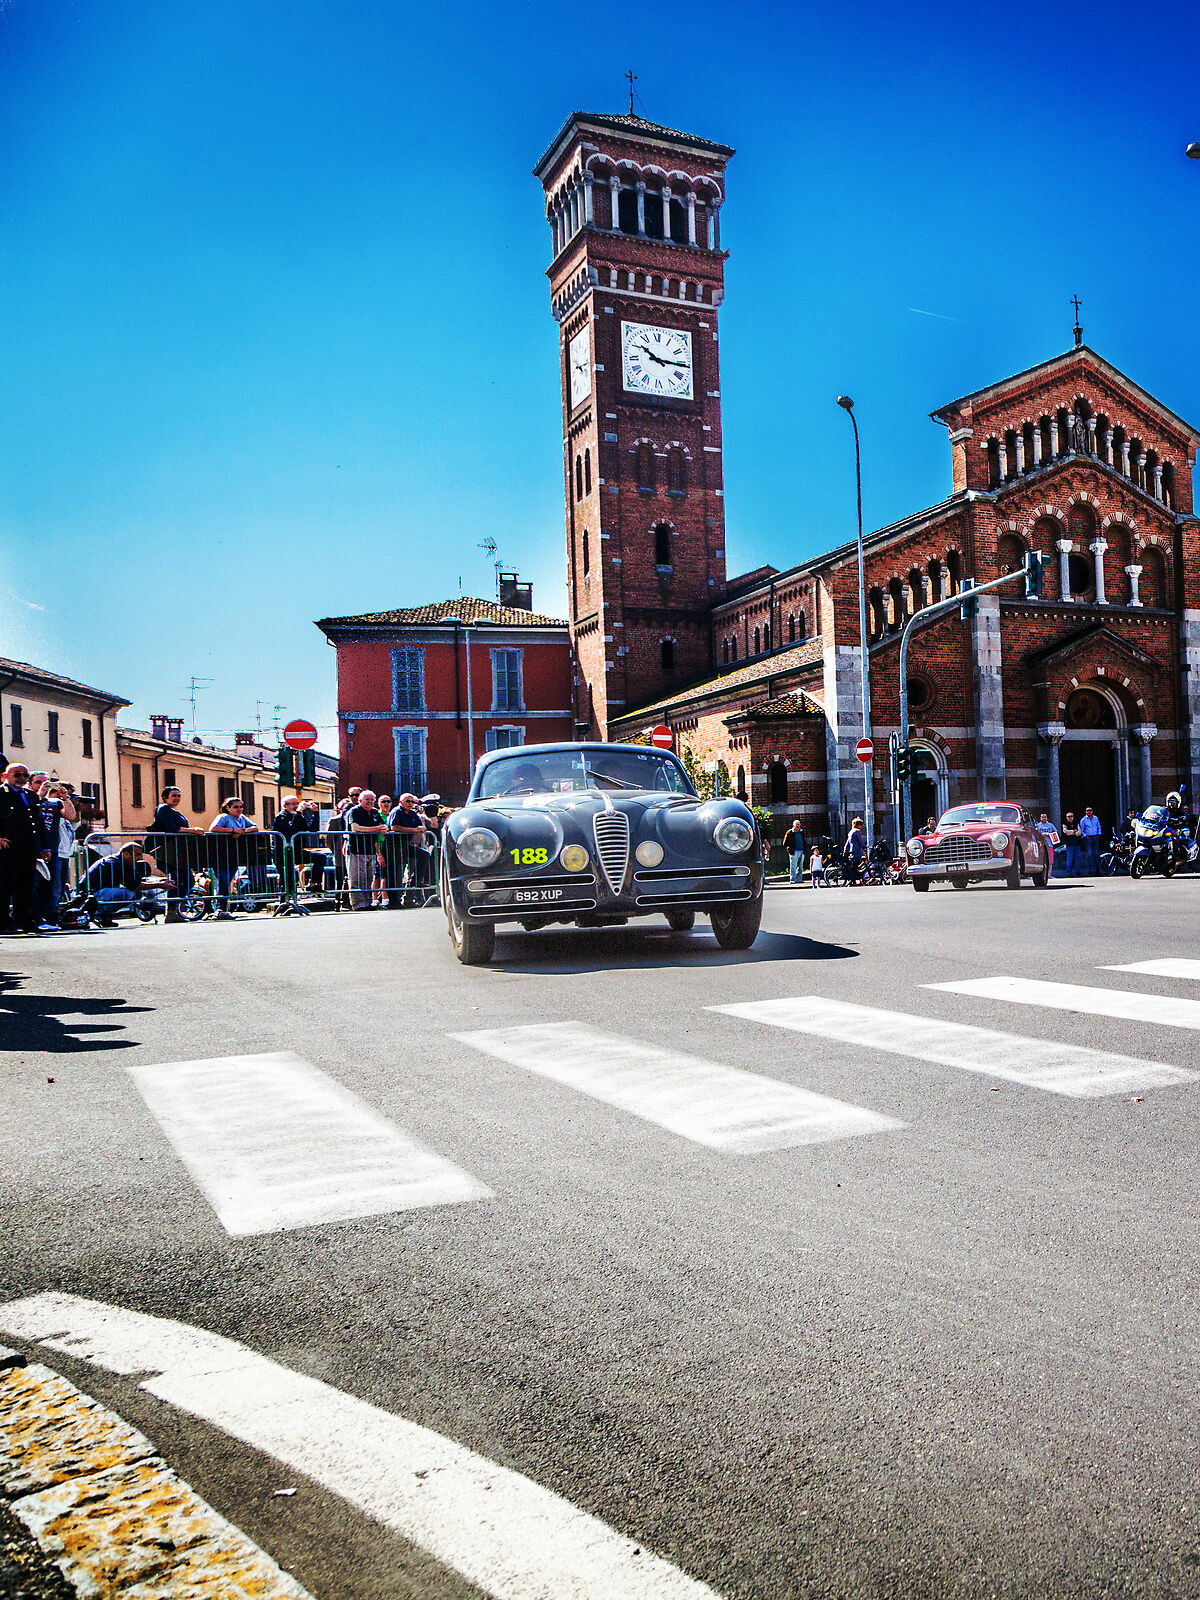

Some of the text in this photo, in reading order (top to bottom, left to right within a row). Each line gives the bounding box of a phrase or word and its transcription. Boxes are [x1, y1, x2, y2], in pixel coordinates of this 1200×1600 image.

[509, 847, 549, 865] 188
[515, 889, 563, 902] 692 XUP
